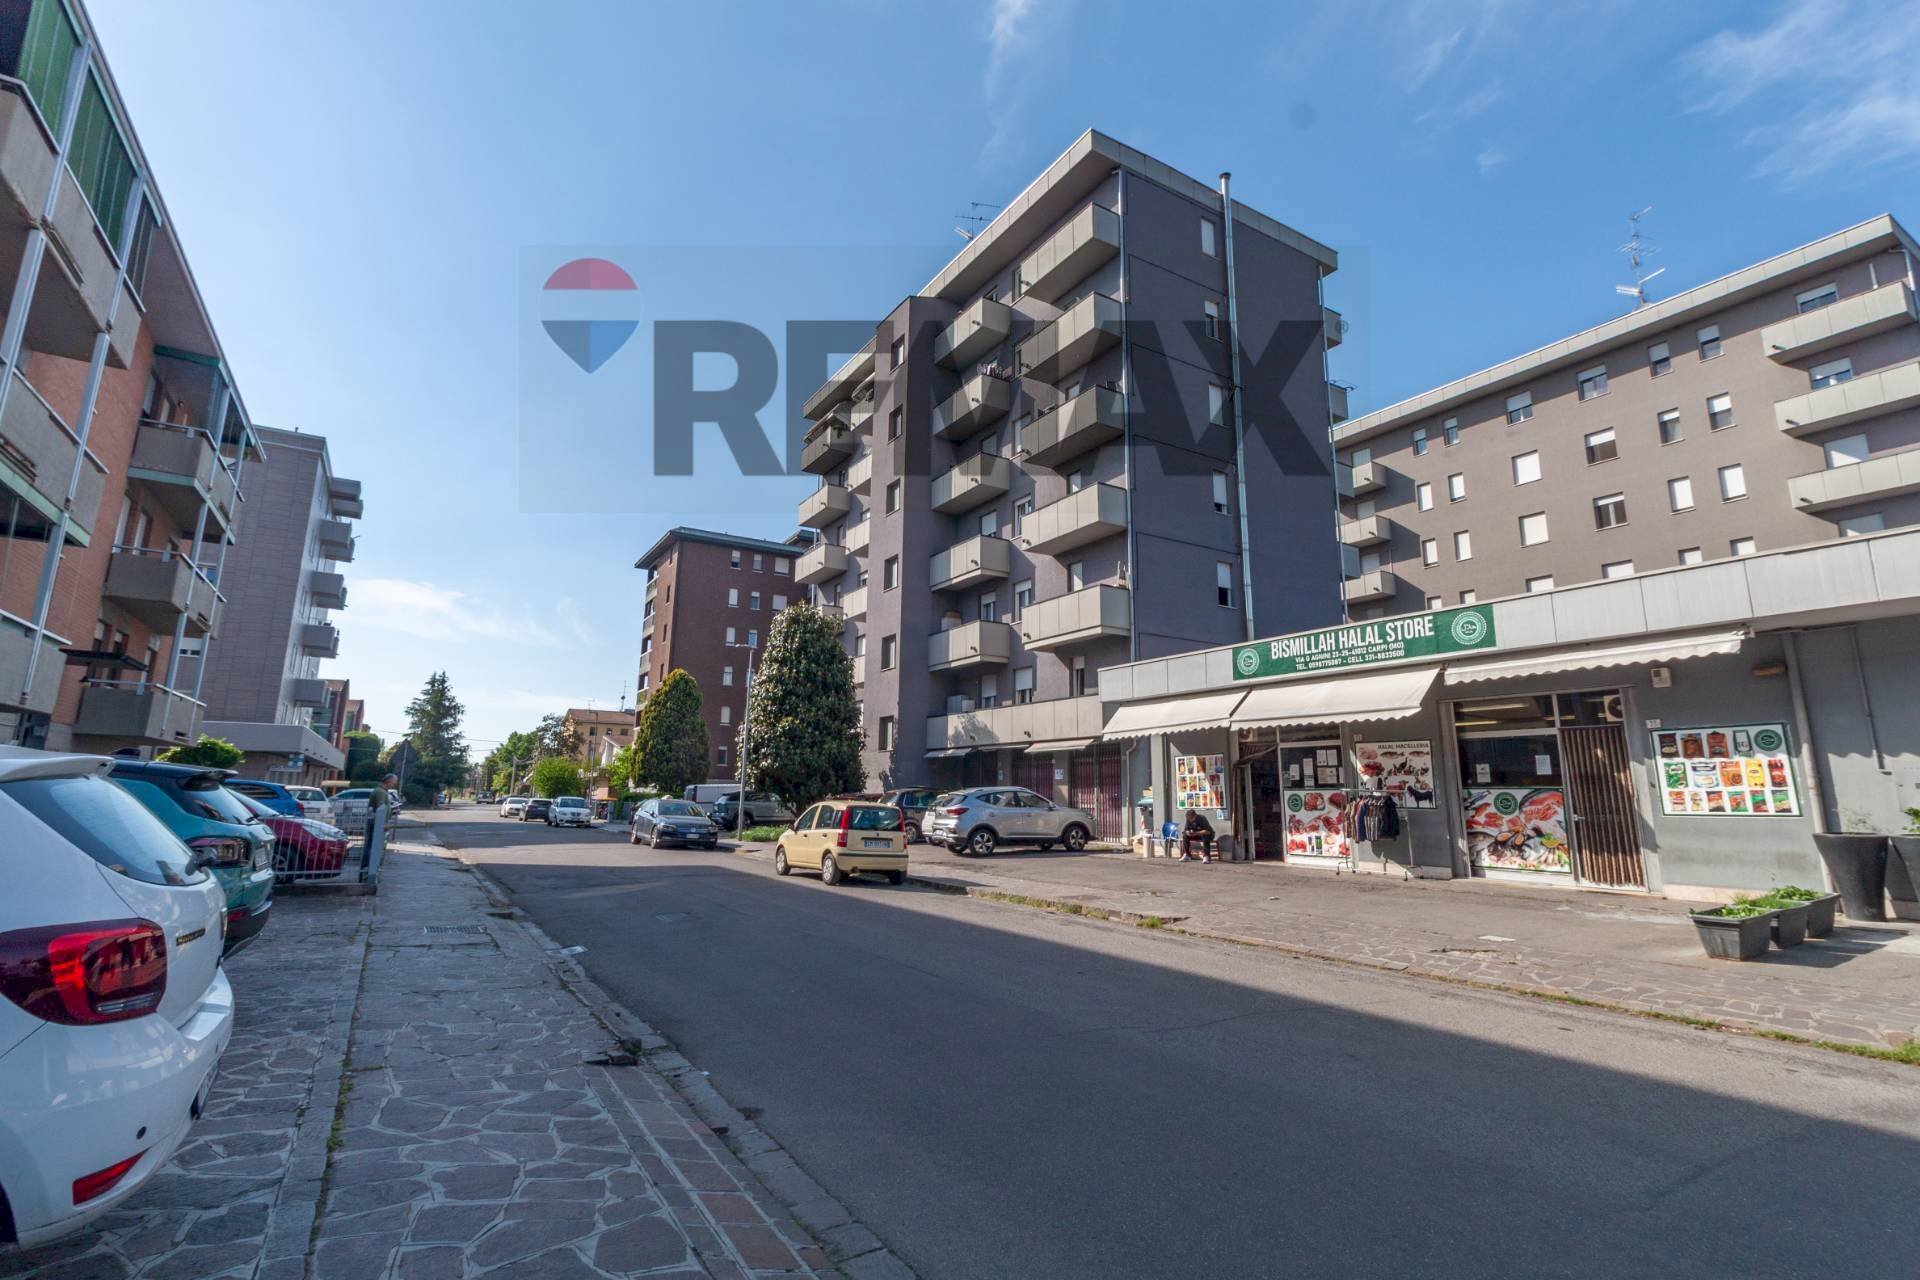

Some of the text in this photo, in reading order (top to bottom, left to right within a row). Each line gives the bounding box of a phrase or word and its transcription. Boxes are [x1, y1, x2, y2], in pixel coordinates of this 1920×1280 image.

[1271, 632, 1335, 659] BISMILLAH
[1339, 625, 1382, 649] HALAL
[1386, 616, 1434, 642] STORE
[1368, 643, 1388, 653] CARPI
[1388, 641, 1404, 650] (MO)
[1347, 654, 1364, 664] CELL
